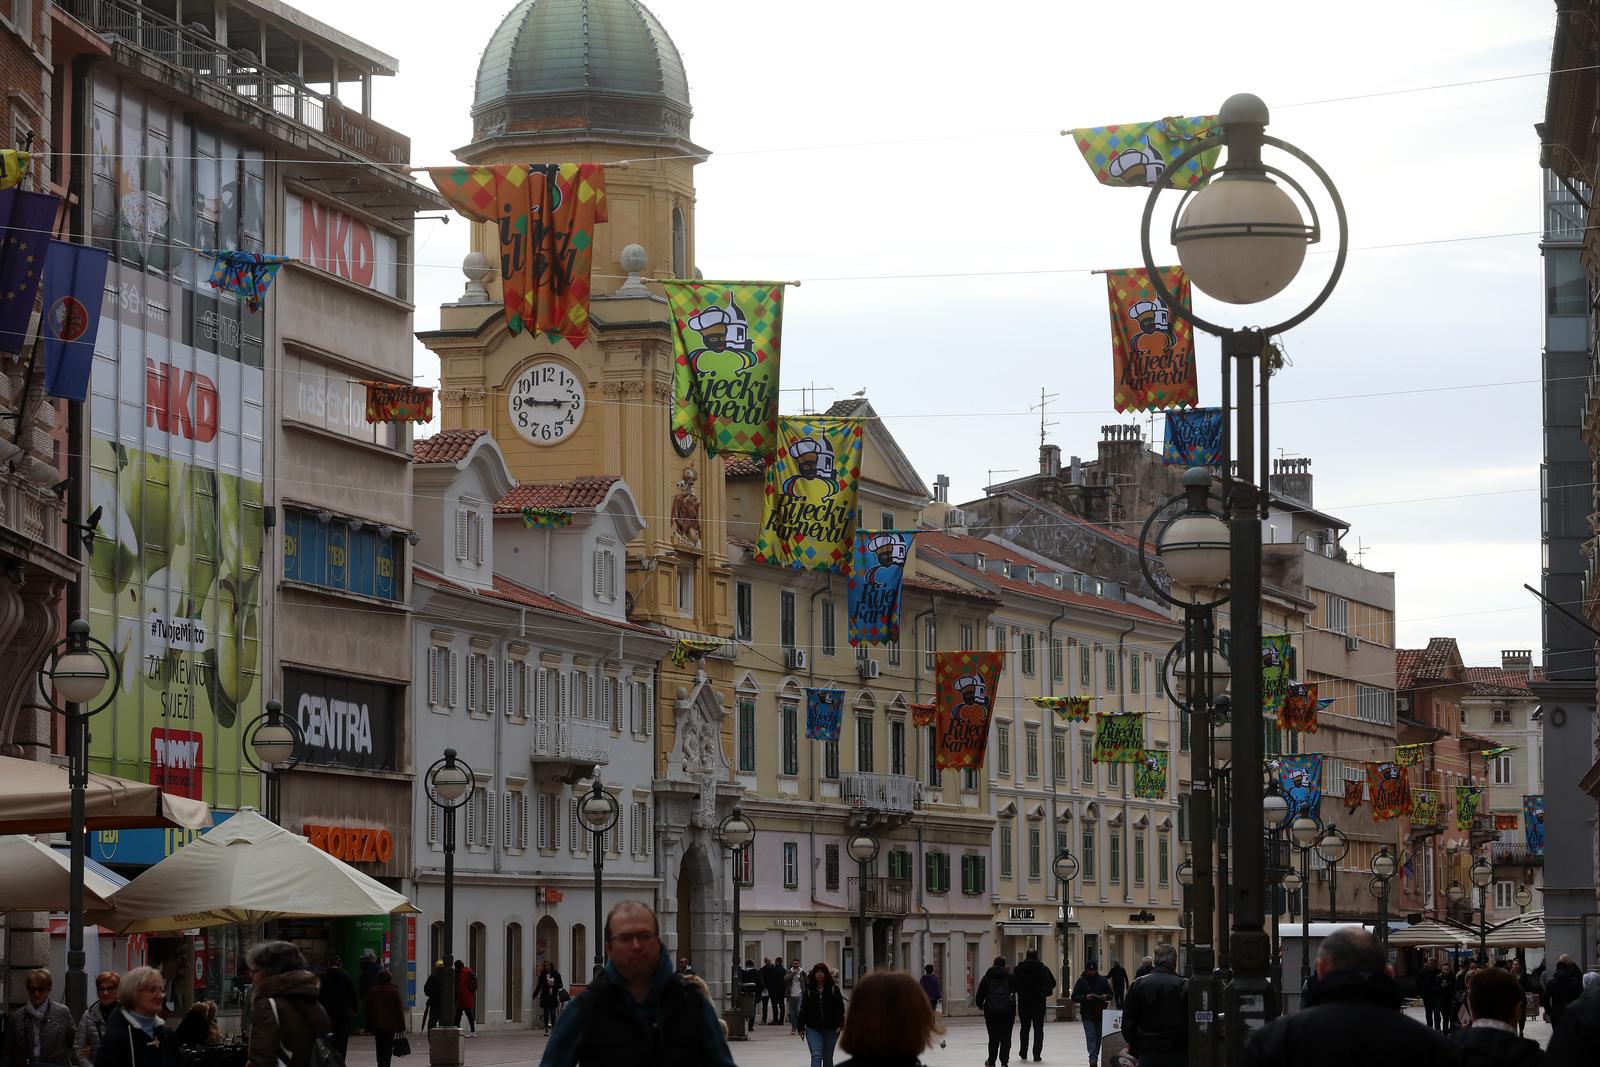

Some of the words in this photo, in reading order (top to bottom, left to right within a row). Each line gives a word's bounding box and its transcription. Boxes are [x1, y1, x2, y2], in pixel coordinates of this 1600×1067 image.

[303, 199, 374, 288] NKD
[203, 309, 247, 350] CENTR
[530, 370, 539, 386] 11
[542, 367, 555, 382] 12
[559, 370, 564, 386] 1
[518, 378, 531, 394] 10
[566, 378, 574, 393] 2
[146, 357, 220, 443] NKD
[512, 395, 523, 411] 9
[571, 394, 580, 409] 3
[518, 411, 528, 427] 8
[565, 409, 574, 424] 4
[530, 422, 540, 437] 7
[541, 424, 551, 440] 6
[554, 421, 564, 436] 5
[766, 509, 850, 543] karneval
[151, 618, 205, 644] #TvojeMito
[297, 693, 372, 755] CENTRA
[155, 738, 199, 769] TOMMY
[304, 824, 394, 864] KORZO
